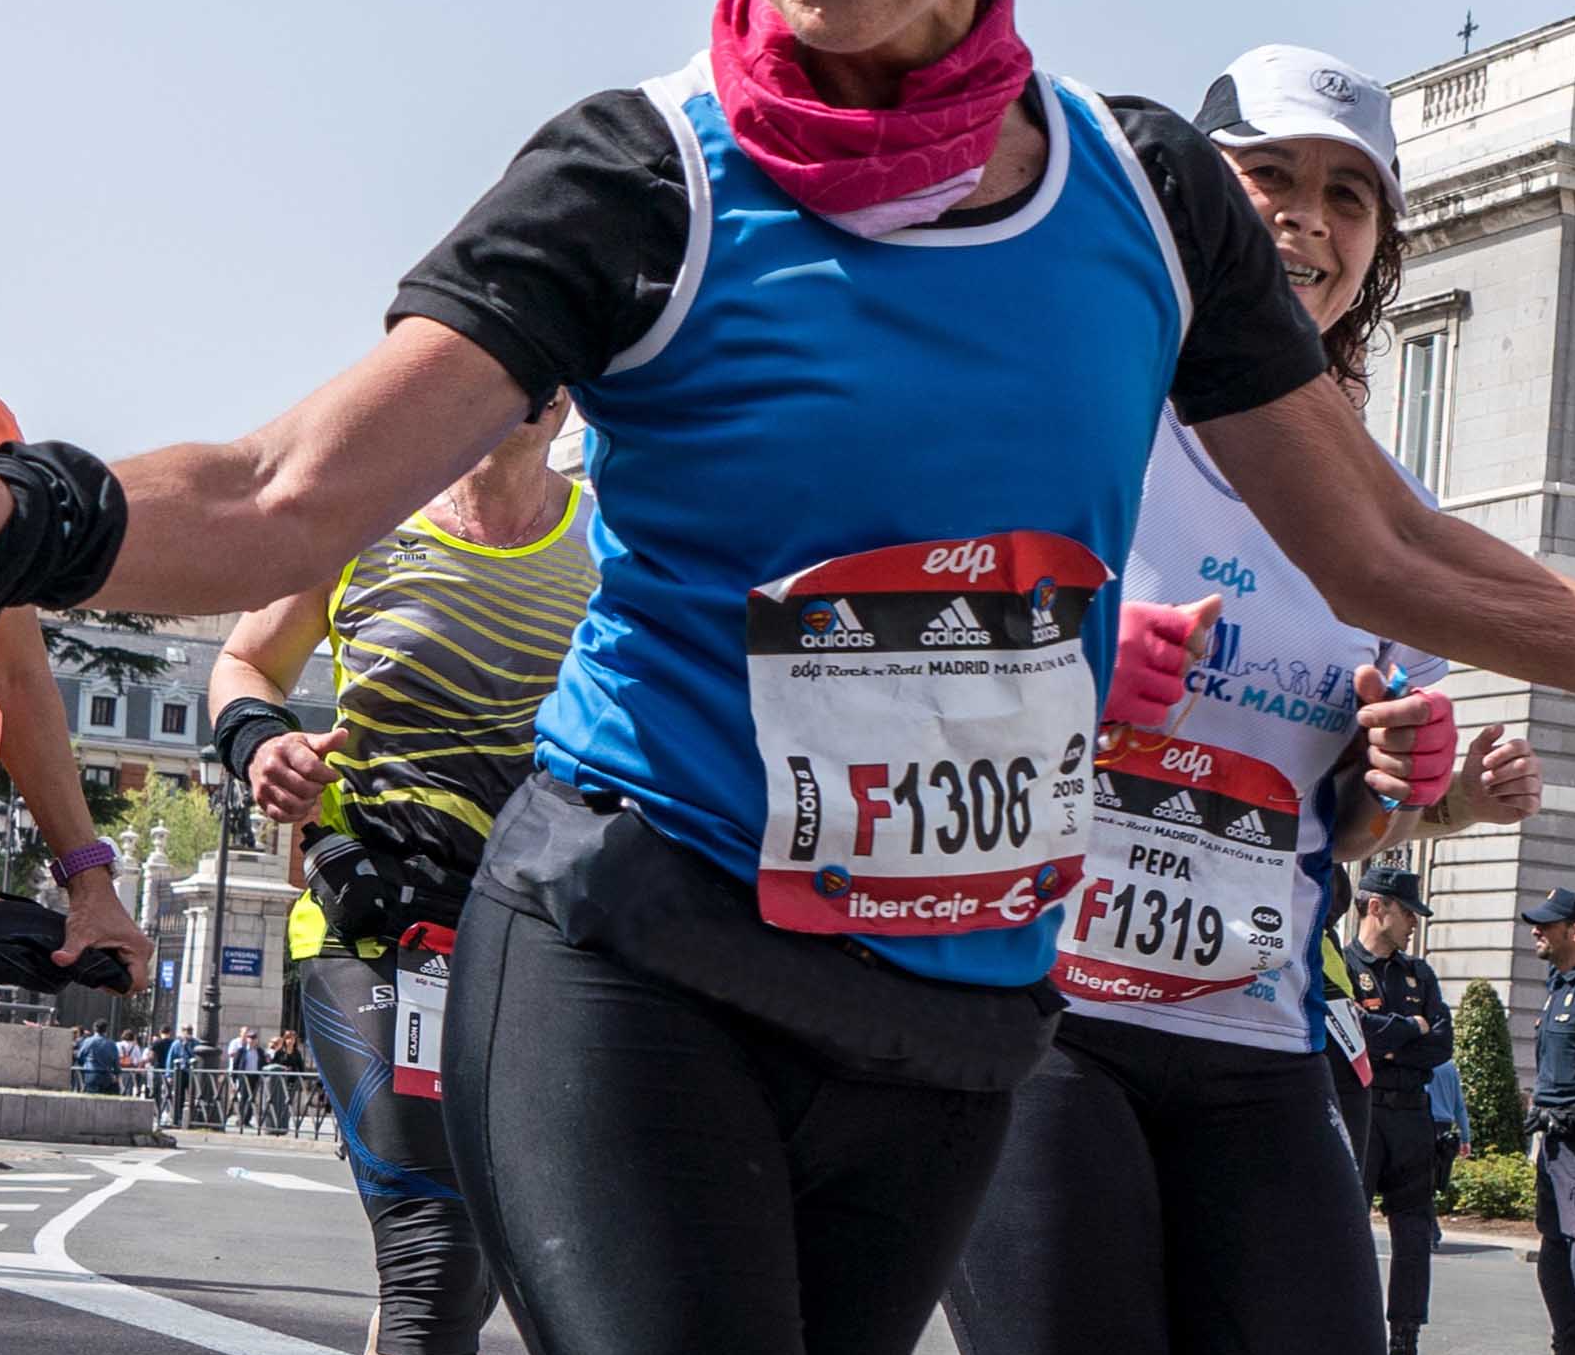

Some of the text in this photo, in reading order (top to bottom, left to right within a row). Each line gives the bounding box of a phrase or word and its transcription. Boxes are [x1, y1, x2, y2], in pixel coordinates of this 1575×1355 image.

[922, 541, 997, 583] edp
[1199, 556, 1256, 597] edp
[801, 626, 875, 648] adidas
[920, 627, 992, 646] adidas
[790, 660, 823, 681] edp
[825, 663, 872, 677] Rock
[885, 663, 923, 676] Roll
[929, 660, 989, 675] MADRID
[1185, 669, 1233, 703] CK.
[1161, 744, 1213, 782] edp
[1053, 777, 1084, 798] 2018
[1093, 792, 1123, 809] das
[797, 782, 817, 848] CAJÓN
[847, 755, 1038, 857] F1306
[1152, 806, 1203, 825] adidas
[1154, 826, 1199, 845] MADRID
[1226, 826, 1273, 846] adidas
[1129, 844, 1192, 882] PEPA
[848, 892, 979, 923] iberCaja
[1073, 876, 1224, 967] F1319
[1248, 933, 1284, 949] 2018
[1065, 965, 1164, 1000] iberCaja
